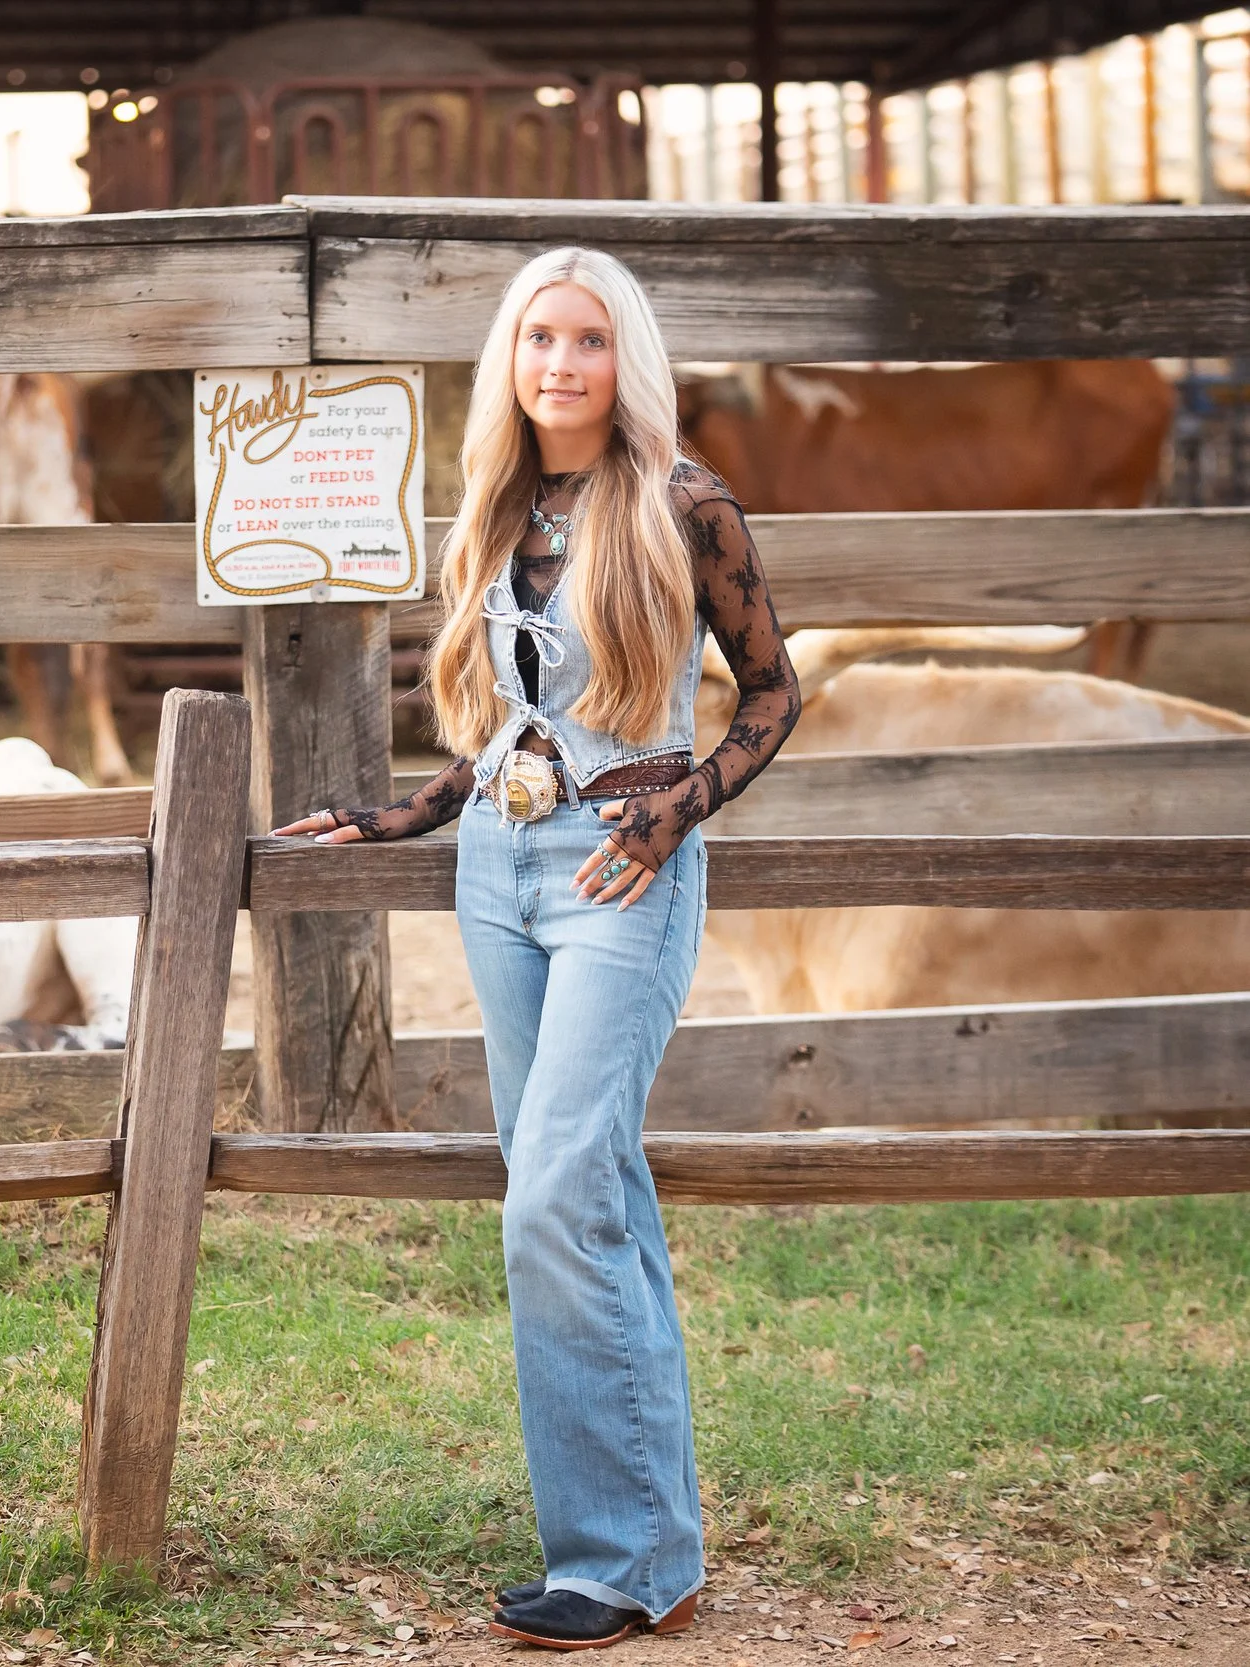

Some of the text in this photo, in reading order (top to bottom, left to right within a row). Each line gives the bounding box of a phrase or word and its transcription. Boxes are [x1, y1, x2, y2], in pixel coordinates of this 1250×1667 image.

[200, 370, 318, 465] Howdy
[328, 405, 387, 421] For your
[309, 425, 353, 443] safety
[358, 426, 367, 437] &
[293, 449, 375, 463] DON'T PET
[290, 473, 305, 484] or
[310, 471, 349, 483] FEED
[234, 499, 256, 511] DO
[260, 498, 292, 510] NOT
[327, 495, 381, 508] STAND
[217, 523, 233, 533] or
[237, 520, 278, 532] LEAN
[282, 520, 316, 531] over
[318, 517, 341, 530] the
